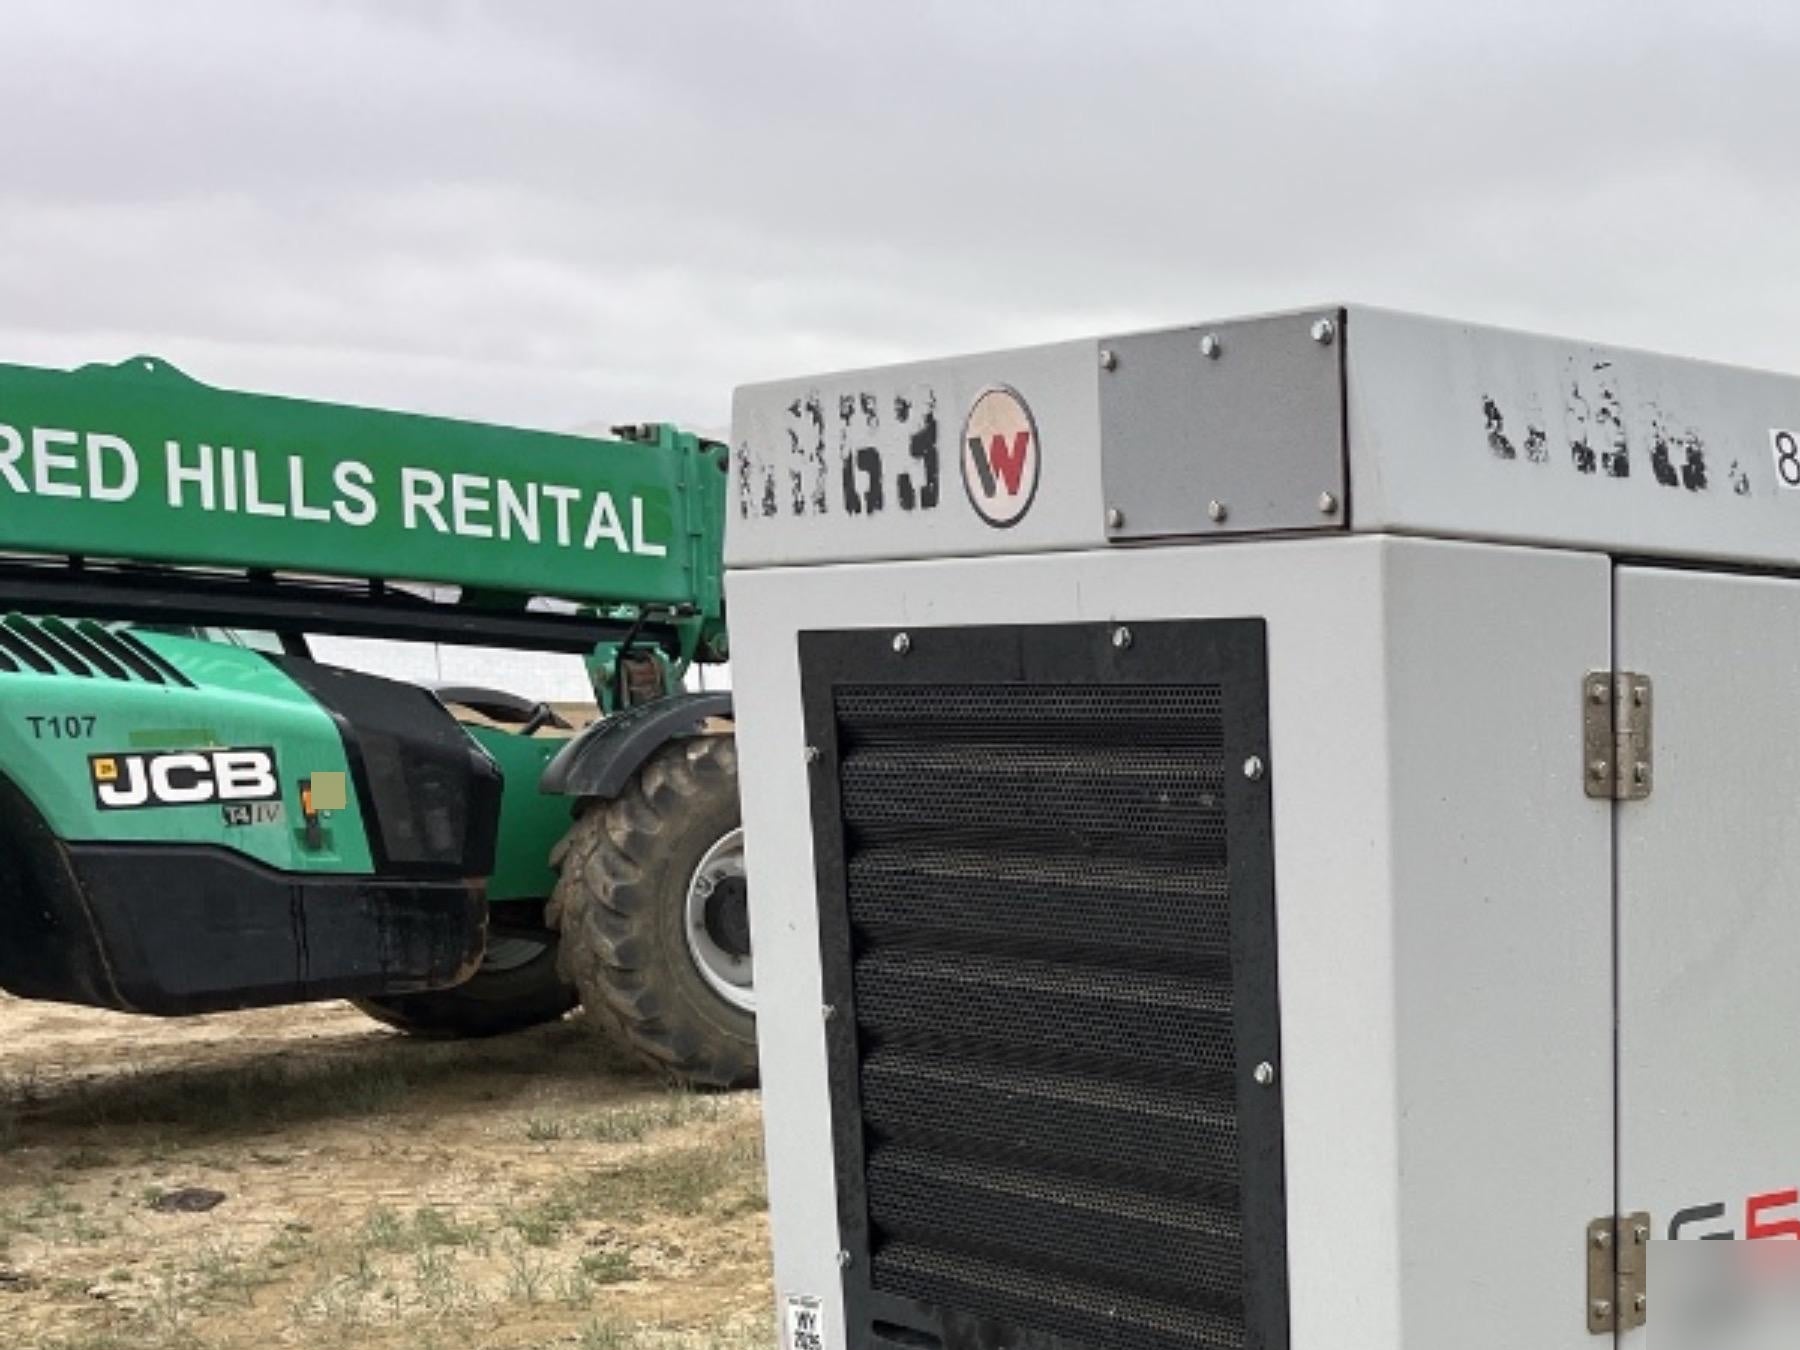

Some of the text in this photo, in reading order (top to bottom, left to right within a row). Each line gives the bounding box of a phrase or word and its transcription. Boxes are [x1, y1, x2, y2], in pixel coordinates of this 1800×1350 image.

[0, 423, 667, 557] RED HILLS RENTAL
[26, 716, 97, 738] T107
[96, 751, 277, 806] JCB
